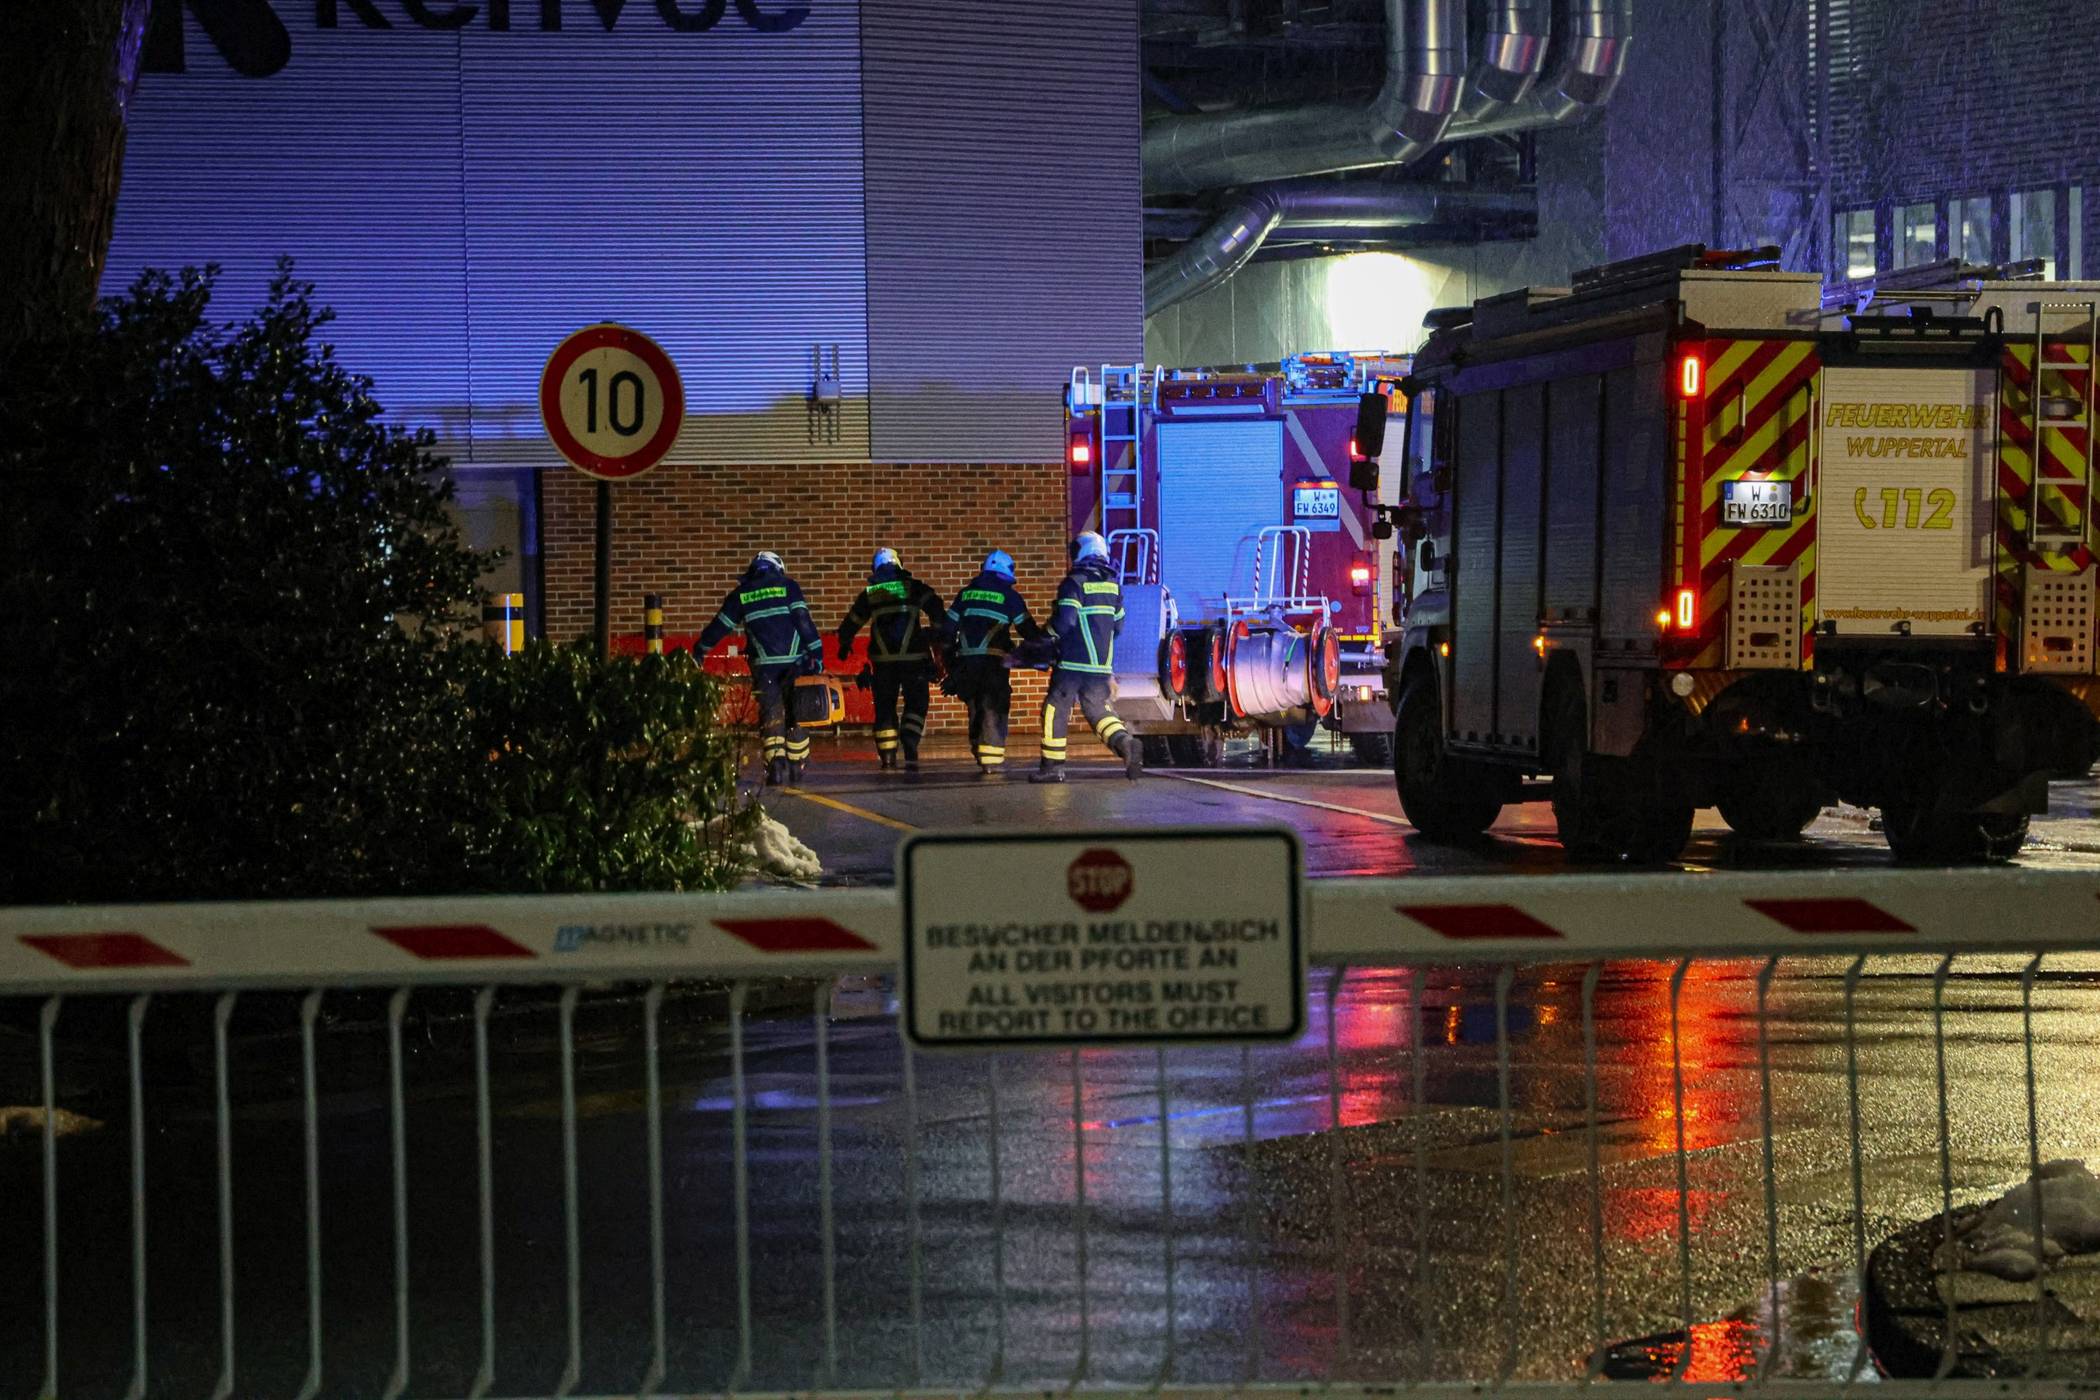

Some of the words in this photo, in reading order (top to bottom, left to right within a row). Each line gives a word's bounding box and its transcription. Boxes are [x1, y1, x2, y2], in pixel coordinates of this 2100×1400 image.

[579, 368, 644, 437] 10
[1826, 403, 1990, 429] FEUERWEHR
[1846, 436, 1968, 458] WUPPERTAL
[1313, 491, 1321, 501] W
[1751, 485, 1761, 501] W
[1296, 502, 1309, 513] FW
[1311, 502, 1336, 514] 6349
[1728, 503, 1747, 519] FW
[1751, 503, 1787, 519] 6310
[1880, 487, 1956, 529] 112
[1071, 866, 1128, 897] STOP
[925, 922, 1079, 948] BESUCHER
[967, 952, 1007, 973] AN
[1016, 950, 1073, 972] DER
[1080, 948, 1188, 971] PFORTE
[1200, 947, 1238, 968] AN
[966, 984, 1015, 1006] ALL
[1024, 981, 1153, 1004] VISITORS
[1162, 979, 1238, 1002] MUST
[938, 1010, 1049, 1034] REPORT
[1063, 1008, 1098, 1030] TO
[1108, 1006, 1158, 1029] THE
[1167, 1004, 1268, 1028] OFFICE
